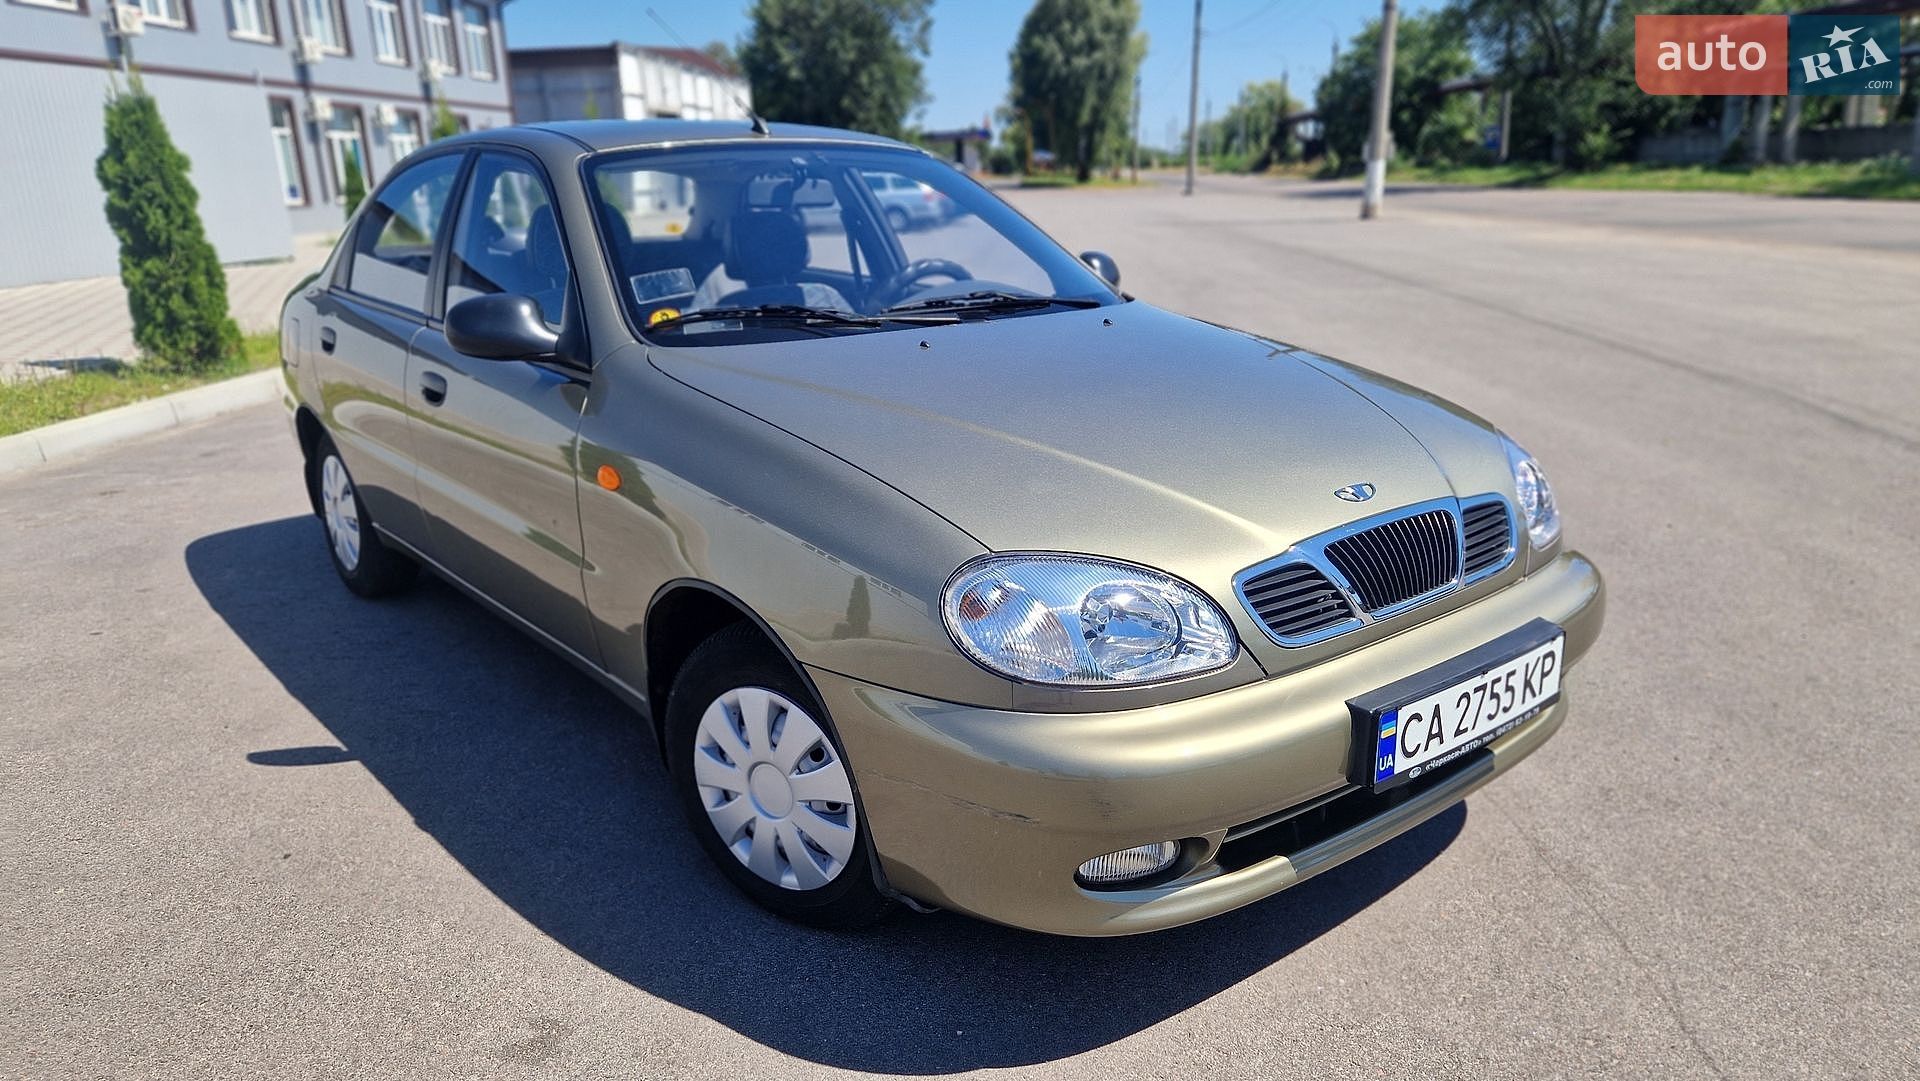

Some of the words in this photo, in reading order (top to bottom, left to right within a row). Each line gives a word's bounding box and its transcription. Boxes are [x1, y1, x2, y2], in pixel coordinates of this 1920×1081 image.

[1400, 703, 1444, 759] CA
[1453, 669, 1517, 738] 2755
[1521, 650, 1556, 705] KP
[1379, 753, 1394, 771] UA
